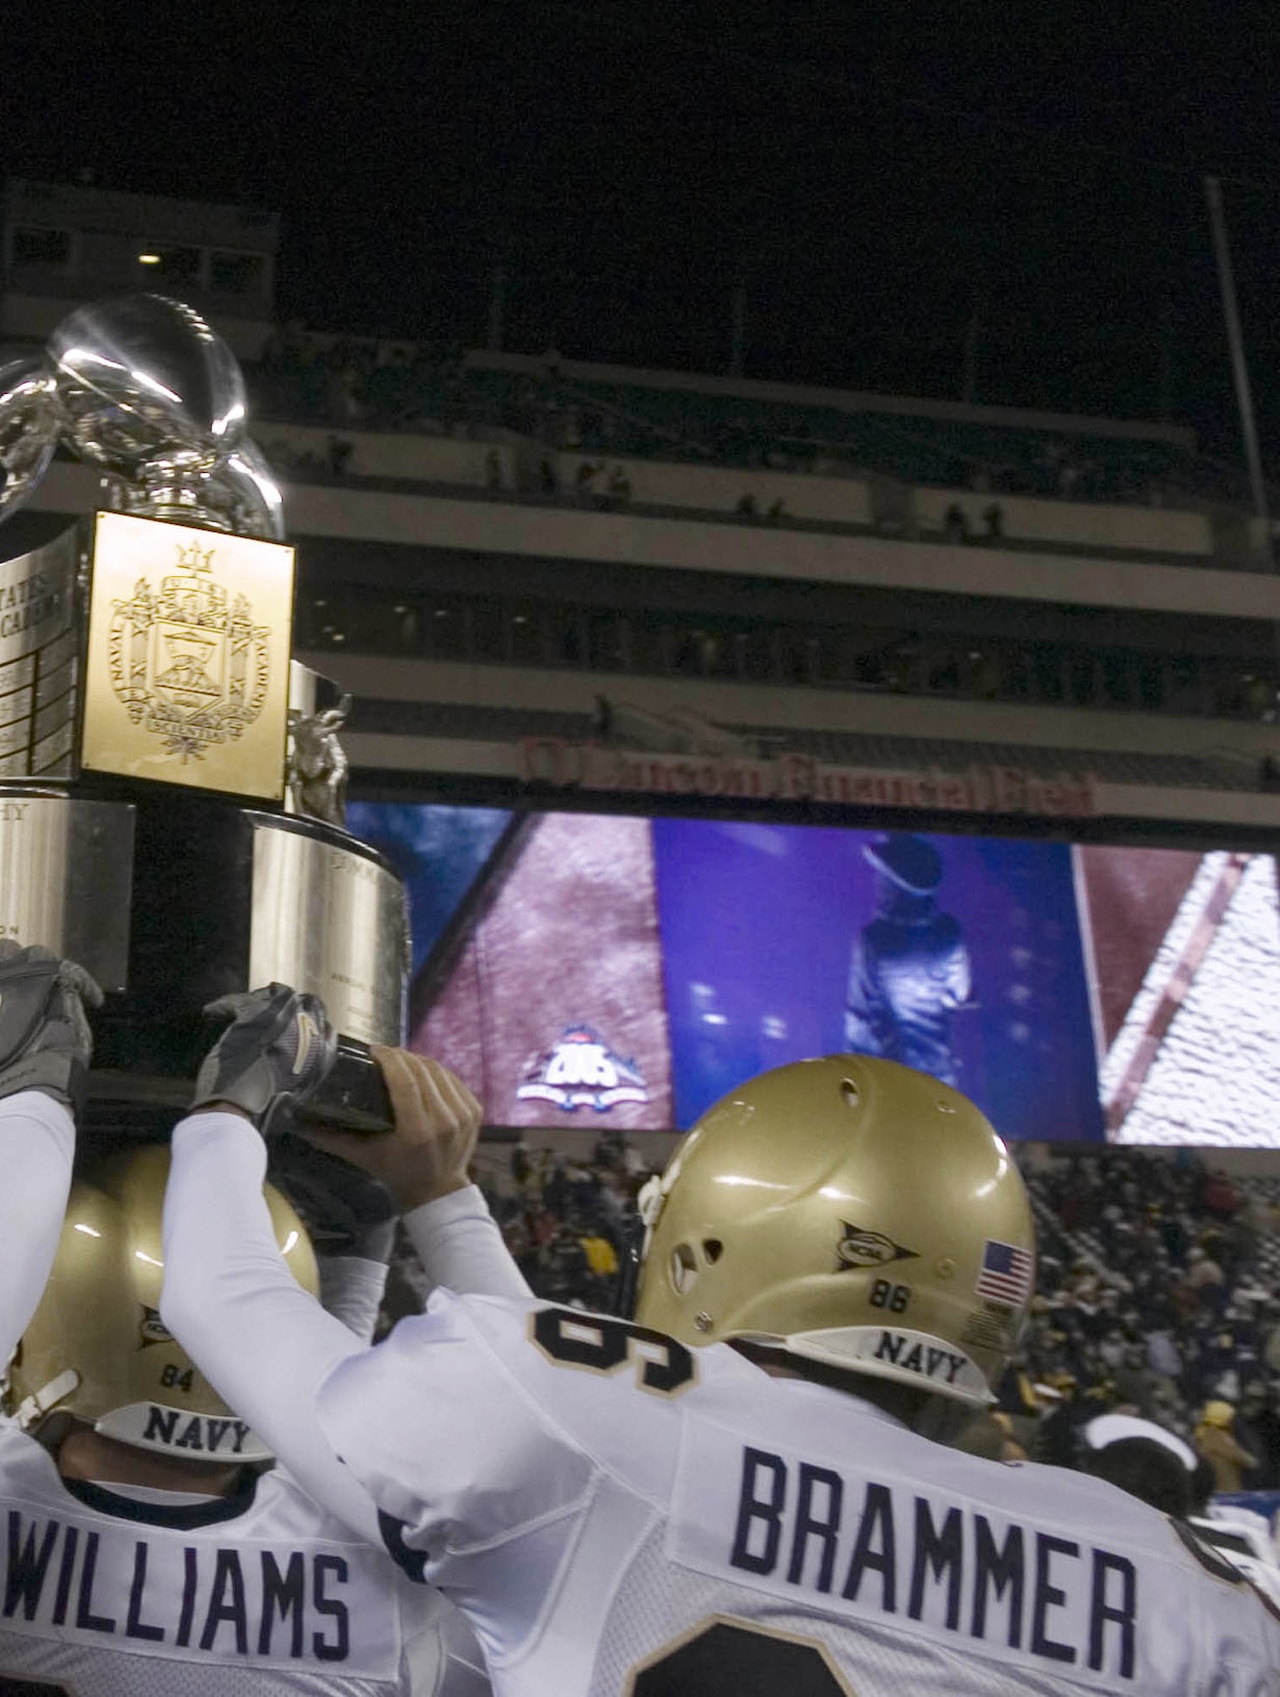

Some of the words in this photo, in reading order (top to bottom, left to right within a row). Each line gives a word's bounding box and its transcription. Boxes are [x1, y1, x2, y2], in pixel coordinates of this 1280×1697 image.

[871, 1279, 911, 1314] 86
[160, 1364, 194, 1393] 84
[875, 1331, 968, 1383] NAVY
[142, 1407, 251, 1454] NAVY
[2, 1510, 349, 1663] WILLIAMS
[729, 1445, 1137, 1680] BRAMMER
